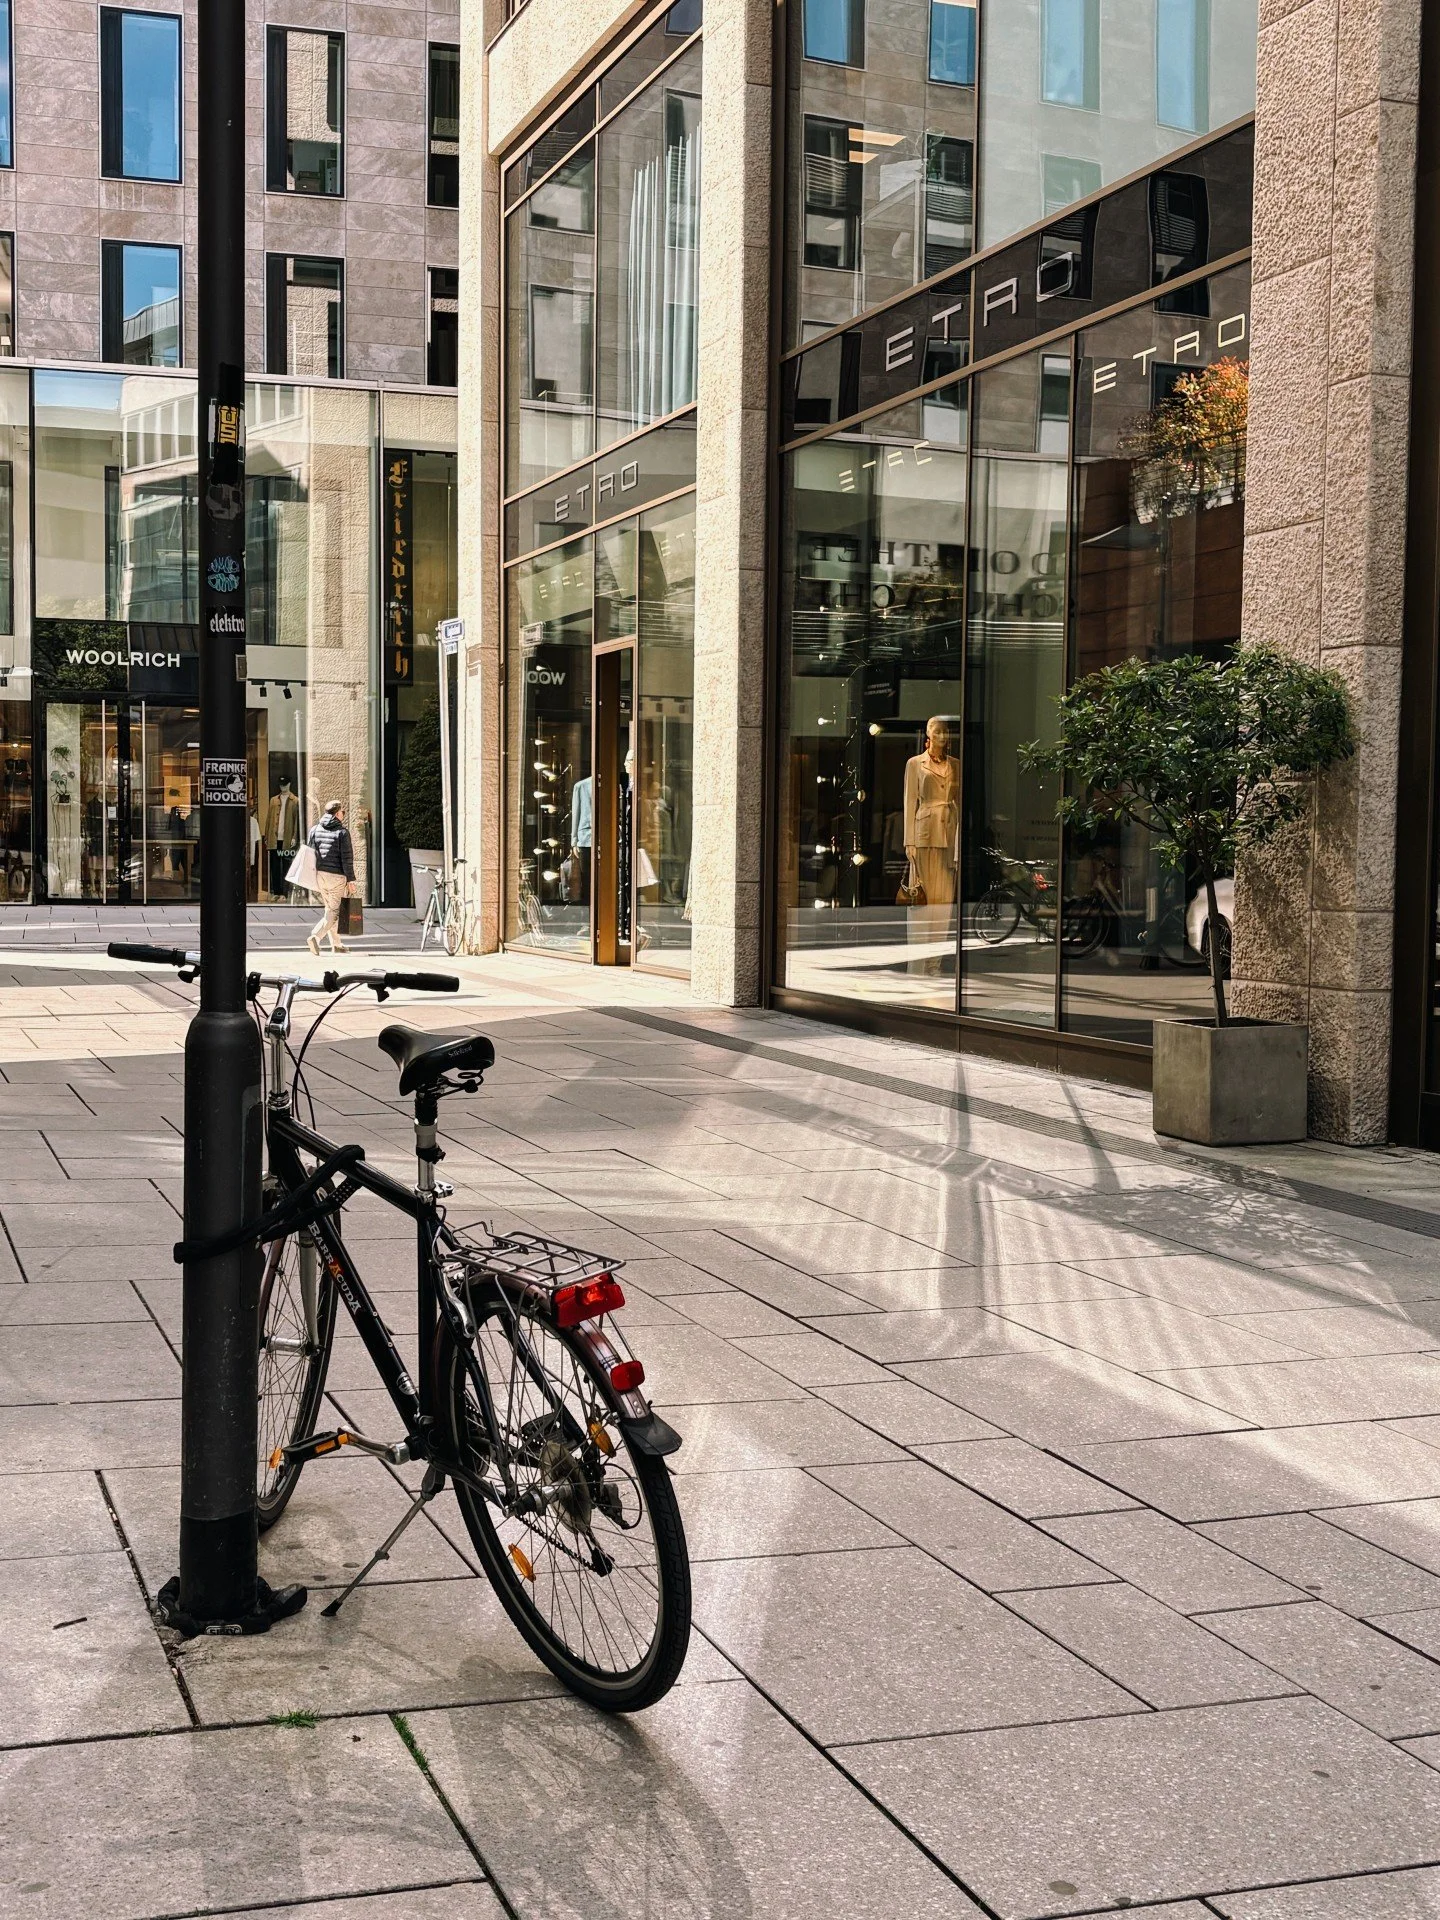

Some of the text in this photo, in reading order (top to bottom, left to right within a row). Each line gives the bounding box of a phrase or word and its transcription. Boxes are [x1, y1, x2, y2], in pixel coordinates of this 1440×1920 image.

[885, 251, 1074, 371] ETRO
[1093, 313, 1246, 394] ETRO
[554, 460, 639, 523] ETRO
[65, 649, 181, 667] WOOLRICH
[207, 778, 224, 786] SEIT
